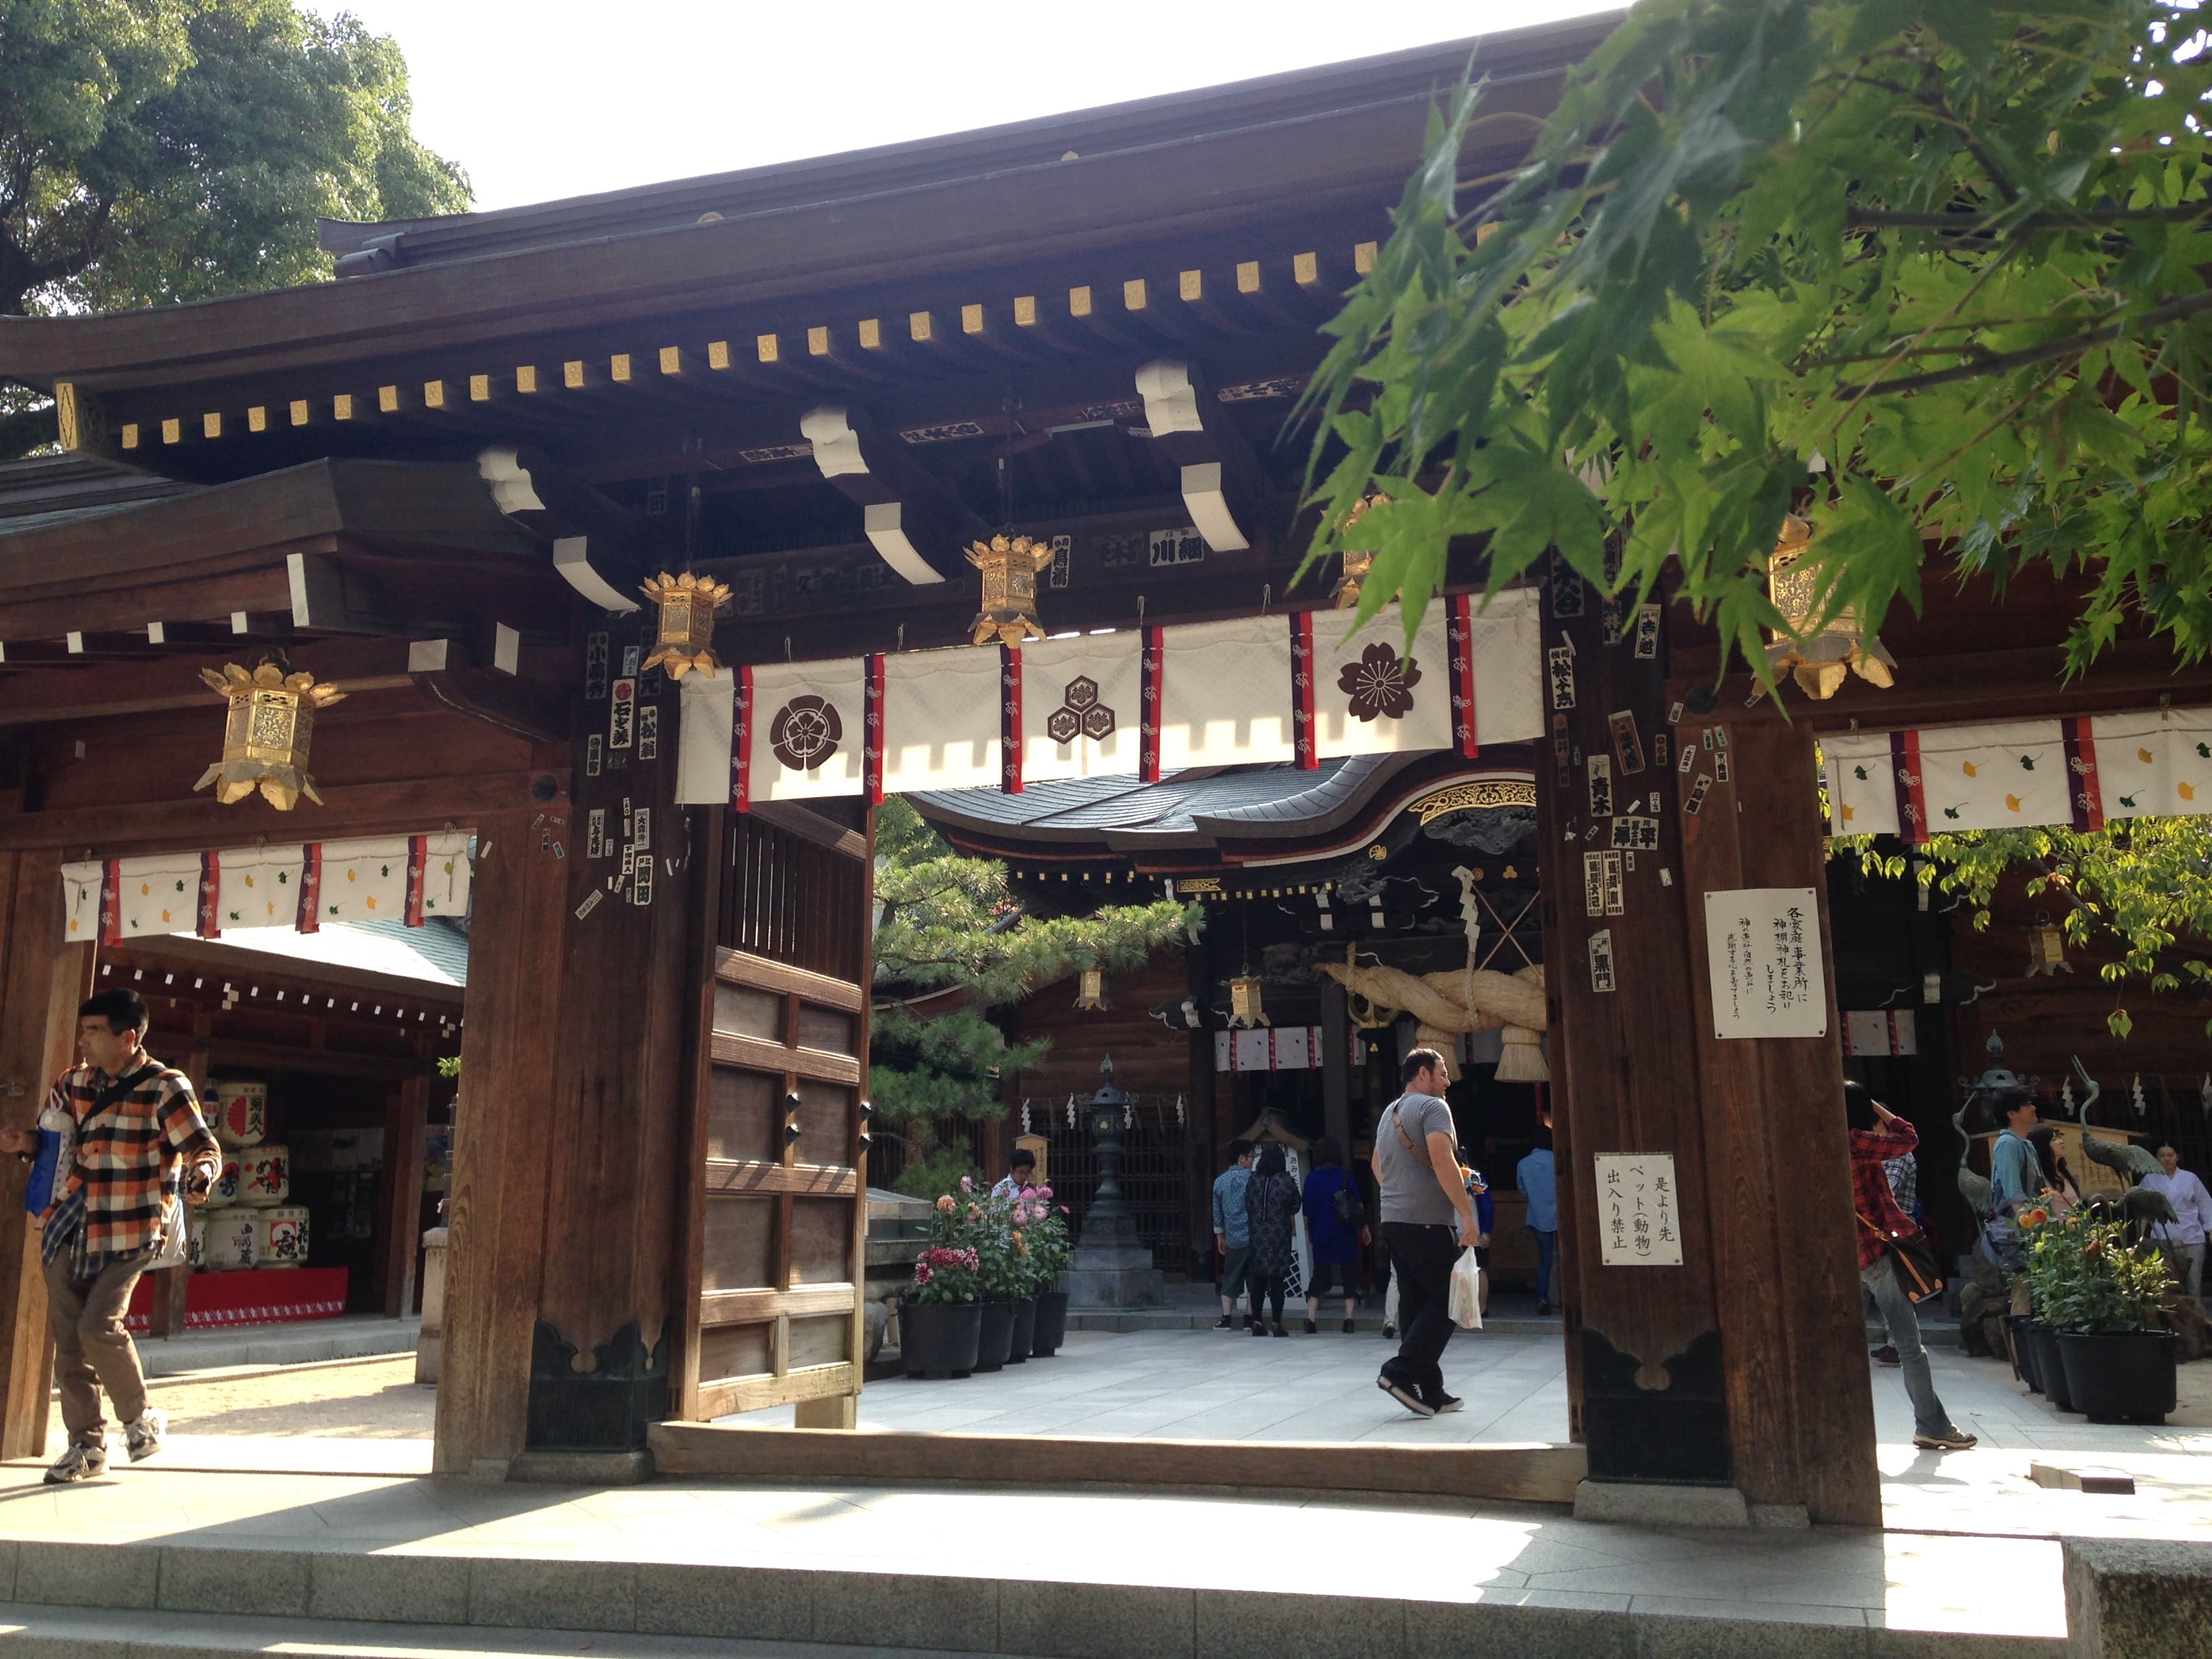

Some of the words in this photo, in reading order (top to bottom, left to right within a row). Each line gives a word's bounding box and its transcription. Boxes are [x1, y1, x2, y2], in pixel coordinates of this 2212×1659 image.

[1152, 537, 1204, 565] 細川
[1592, 777, 1610, 815] 青木
[1607, 1169, 1627, 1250] 出入り禁止
[1655, 1177, 1675, 1242] 是より先
